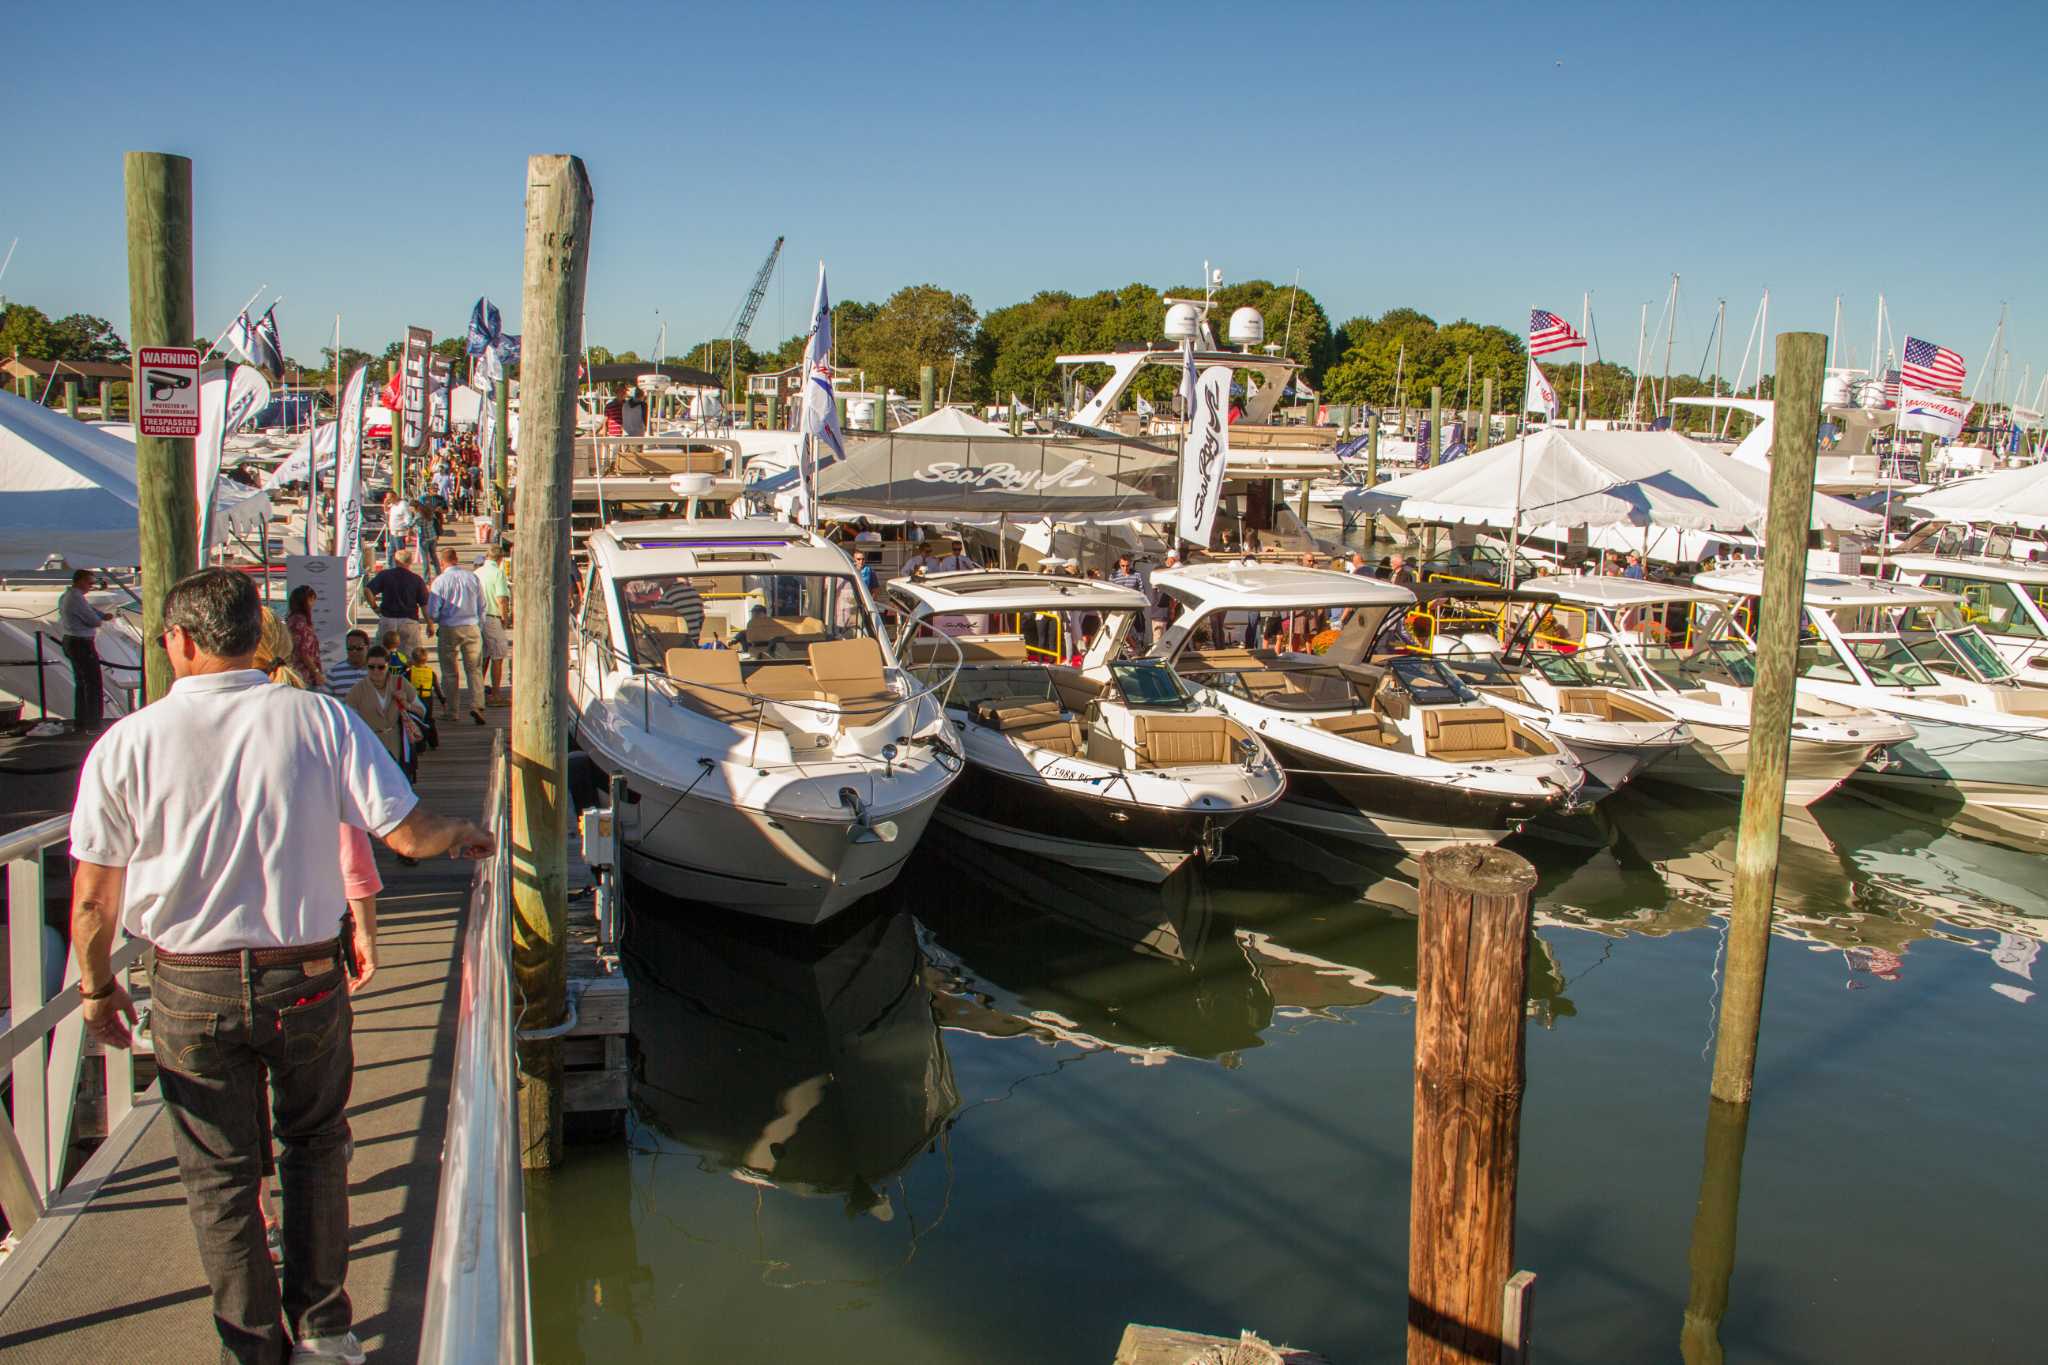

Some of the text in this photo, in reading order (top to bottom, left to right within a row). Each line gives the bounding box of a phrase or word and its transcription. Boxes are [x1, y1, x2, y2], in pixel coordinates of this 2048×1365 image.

[142, 352, 197, 365] WARNING
[144, 418, 198, 426] TRESPASSERS
[144, 425, 196, 433] PROSECUTED
[913, 462, 1041, 493] Sea Ray
